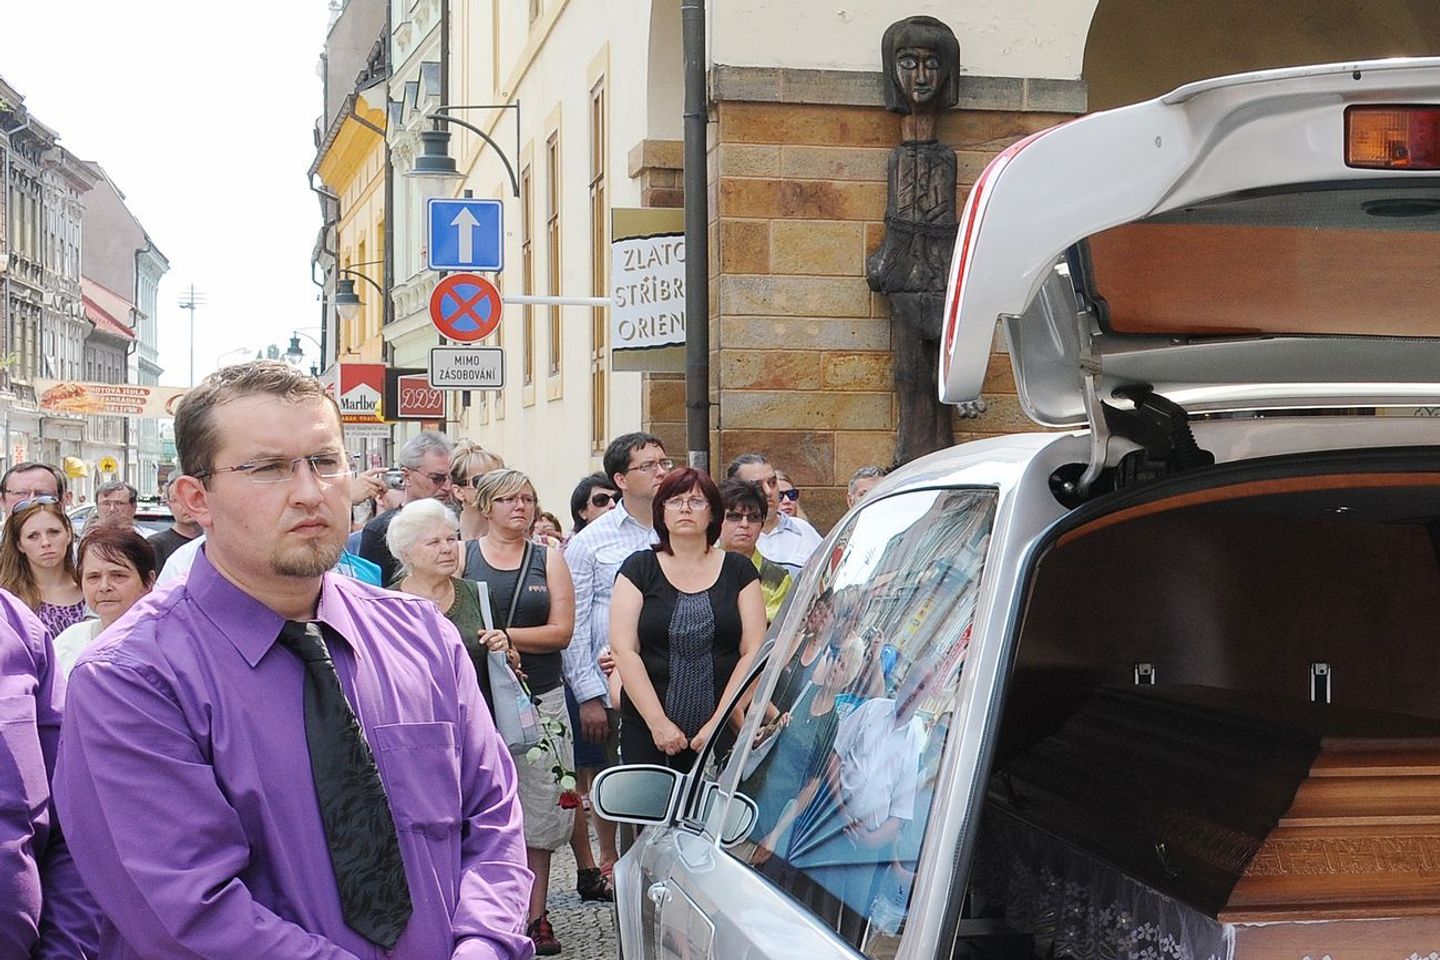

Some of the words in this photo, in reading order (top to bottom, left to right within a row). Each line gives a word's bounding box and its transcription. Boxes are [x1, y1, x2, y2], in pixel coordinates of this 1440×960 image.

[615, 275, 685, 308] STŘÍBR
[618, 312, 685, 341] ORIEN
[454, 355, 480, 366] MIMO
[439, 367, 497, 381] ZÁSOBOVÁNÍ
[340, 394, 376, 410] Marlbo
